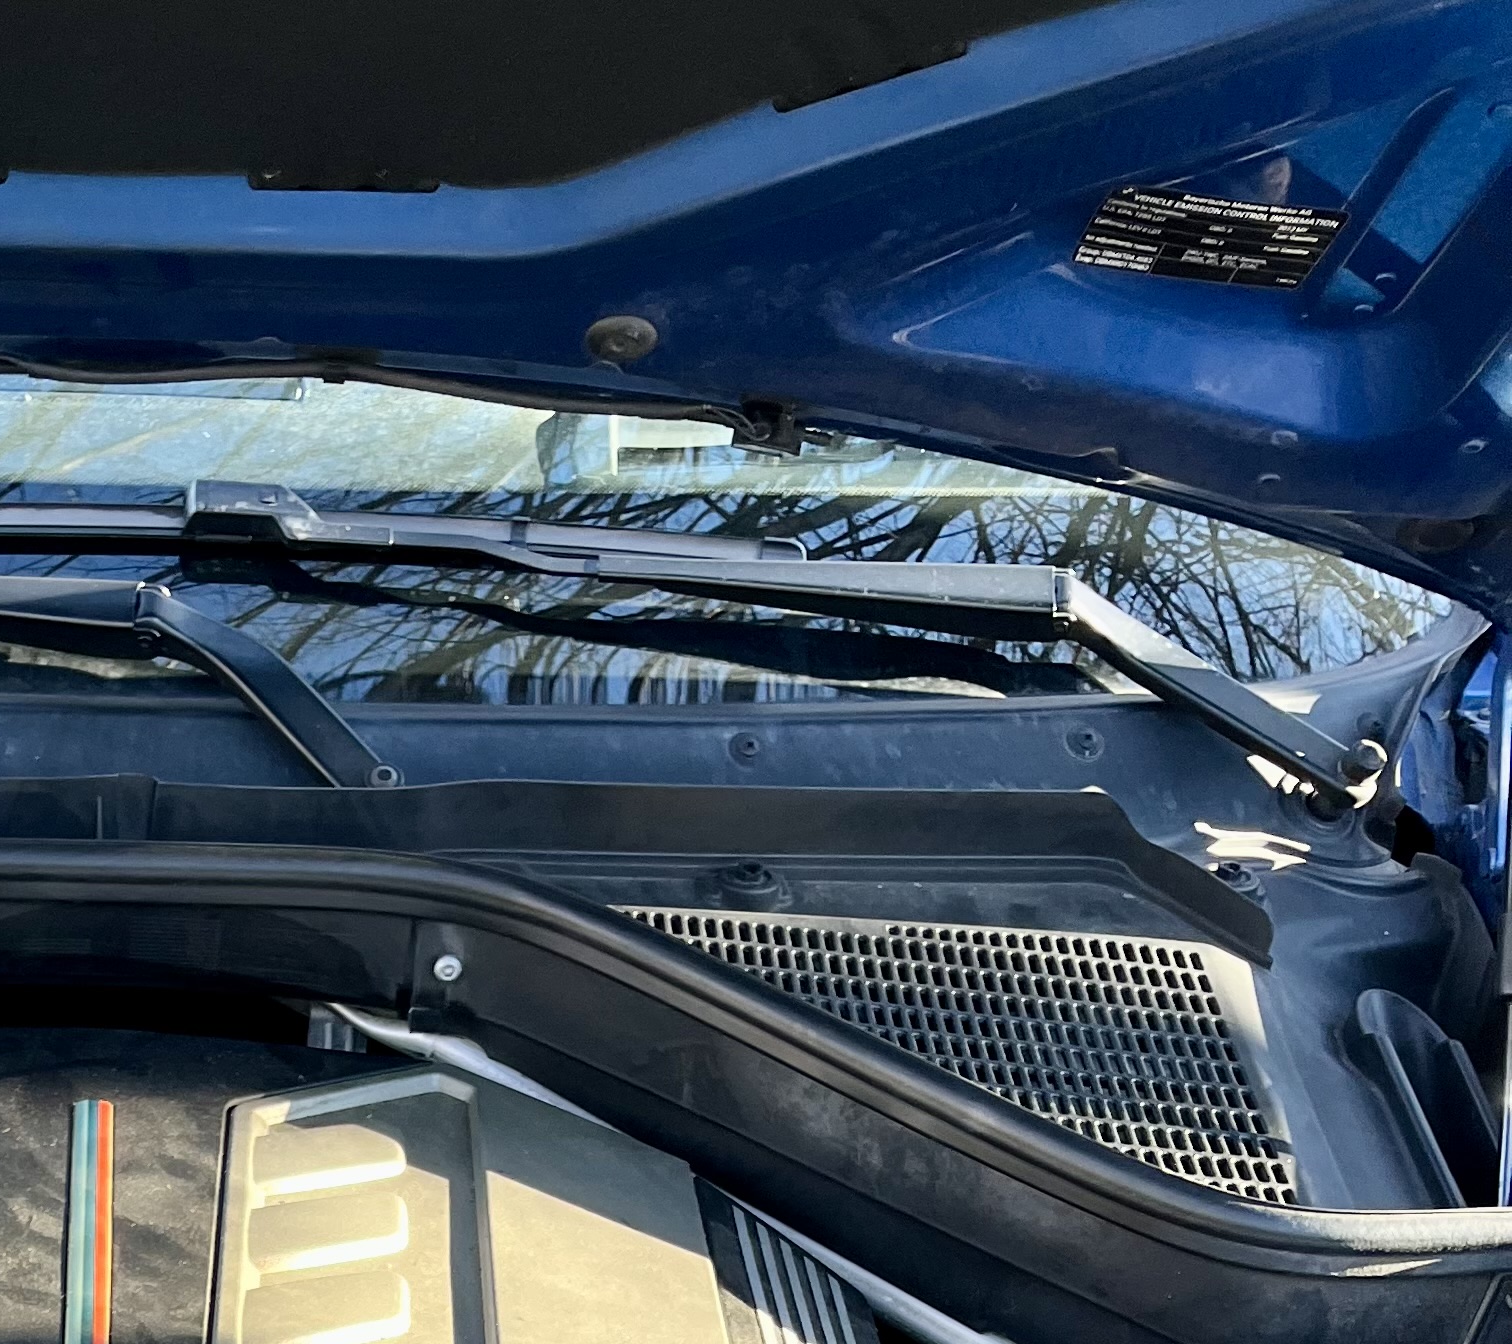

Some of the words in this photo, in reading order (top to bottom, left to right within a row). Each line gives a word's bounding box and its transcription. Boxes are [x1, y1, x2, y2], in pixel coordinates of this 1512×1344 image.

[1134, 194, 1175, 207] VEHICLE
[1173, 200, 1223, 215] EMISSION
[1222, 208, 1269, 221] CONTROL
[1268, 214, 1340, 229] INFORMATION
